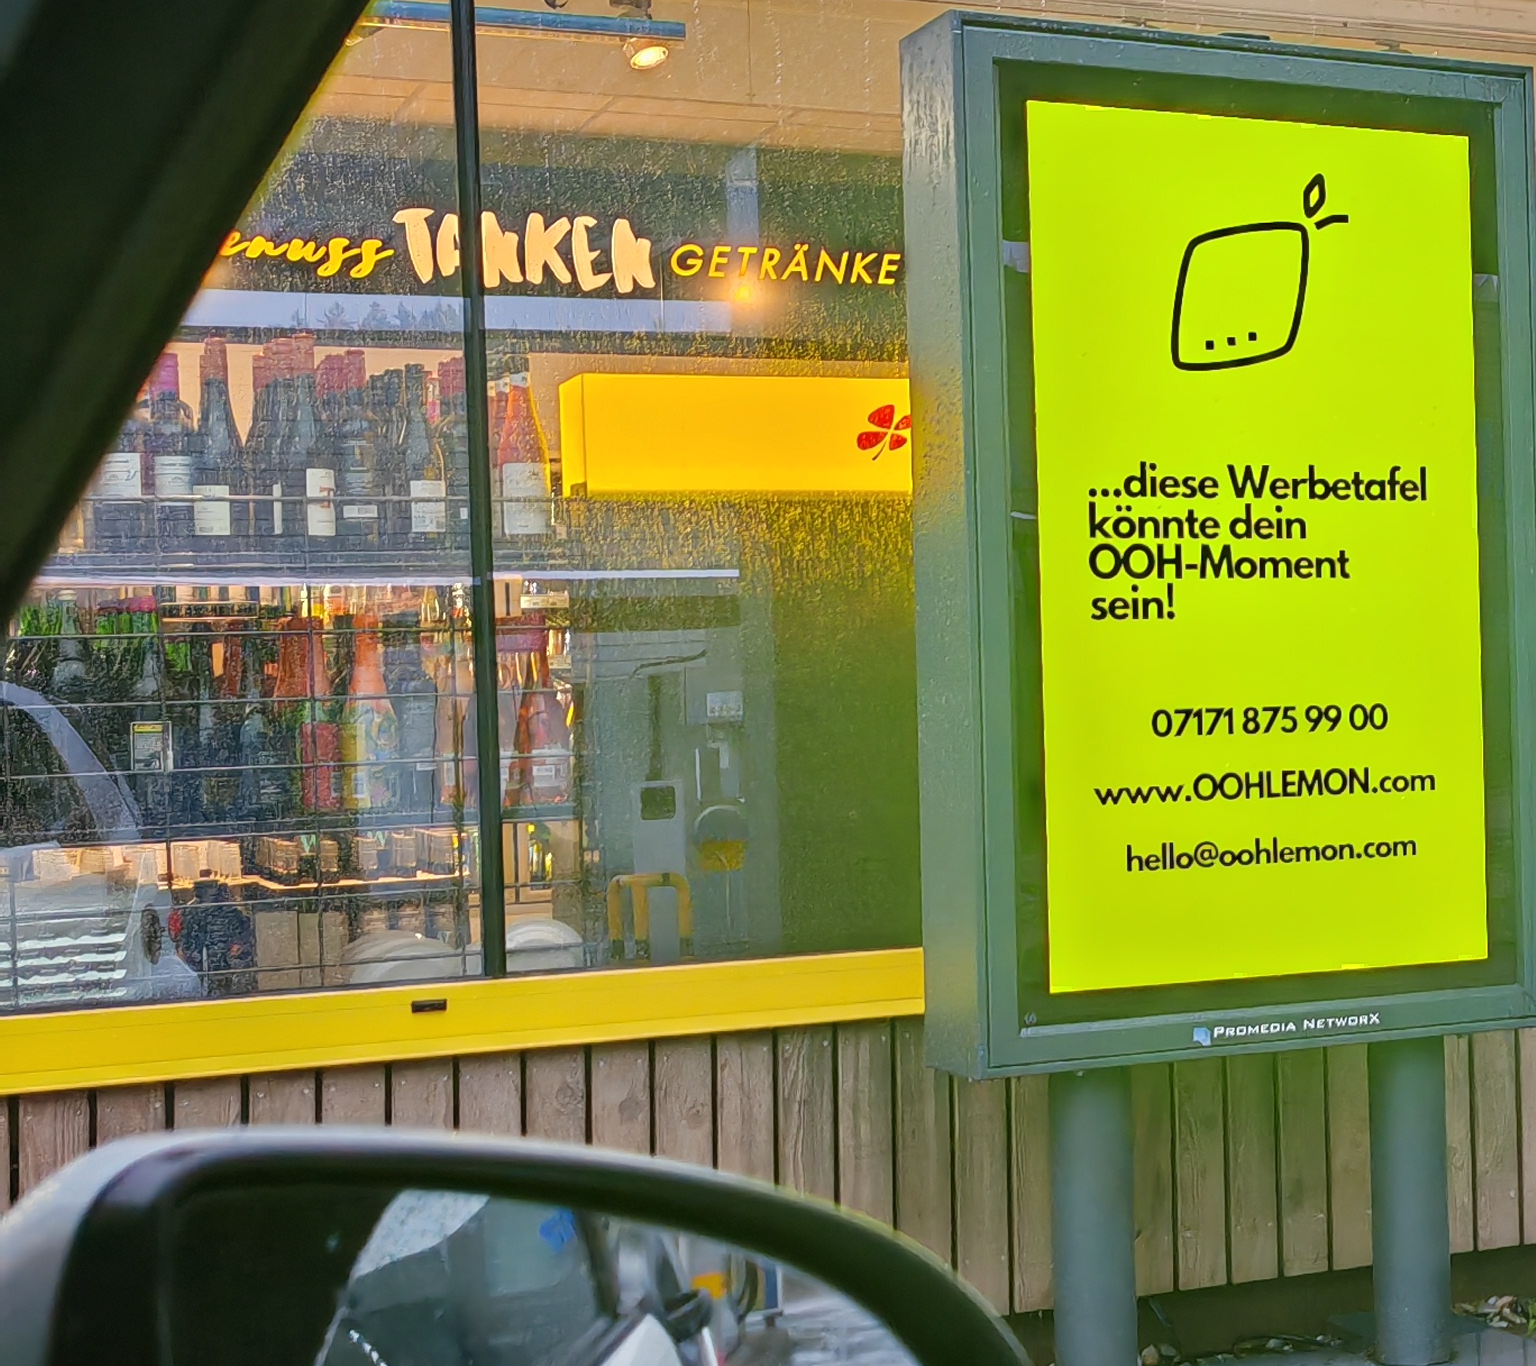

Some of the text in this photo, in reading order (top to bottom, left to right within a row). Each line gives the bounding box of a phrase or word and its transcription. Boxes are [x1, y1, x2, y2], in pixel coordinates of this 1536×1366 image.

[391, 207, 655, 294] TANKEN
[669, 241, 901, 286] GETRÄNKE
[1088, 461, 1428, 502] ...diese Werbetafel
[1088, 502, 1307, 540] könnte dein
[1088, 543, 1350, 579] OOH-Moment
[1090, 583, 1176, 620] sein!
[1151, 703, 1388, 738] 07171 875 99 00
[1093, 767, 1436, 806] www.OOHLEMON.com
[1126, 837, 1417, 872] hello@oohlemon.com
[1213, 1012, 1381, 1039] PROMEDIA NETWORX
